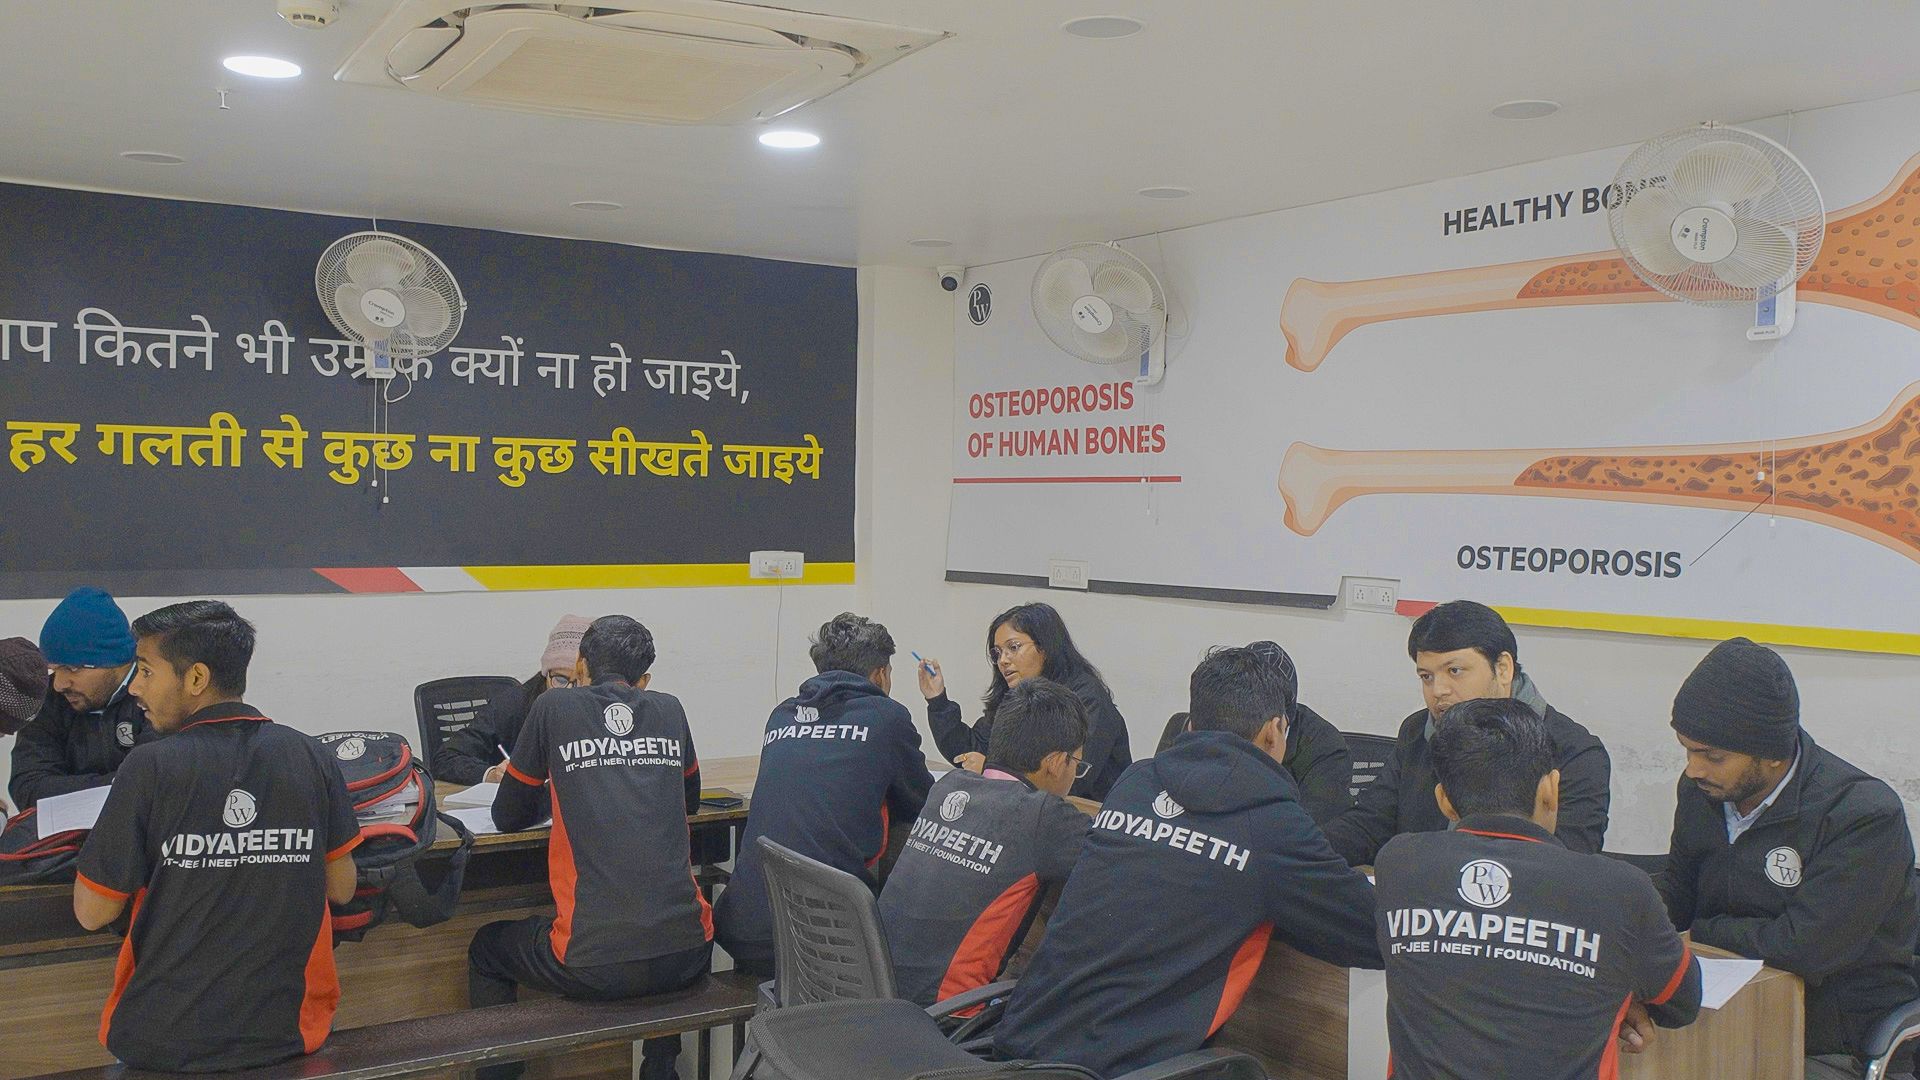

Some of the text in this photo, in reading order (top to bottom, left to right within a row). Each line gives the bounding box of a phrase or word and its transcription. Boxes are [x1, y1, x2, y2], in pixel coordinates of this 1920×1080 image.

[1443, 191, 1573, 236] HEALTHY
[73, 307, 219, 371] कितने
[236, 320, 295, 374] भी
[449, 336, 524, 386] क्यों
[536, 352, 579, 389] ना
[591, 343, 631, 398] हो
[643, 350, 750, 404] जाइये,
[969, 382, 1135, 418] OSTEOPOROSIS
[7, 412, 823, 487] हर गलती से कुछ ना कुछ सीखते जाइये
[968, 424, 1166, 458] OF HUMAN BONES
[1457, 545, 1682, 578] OSTEOPOROSIS
[558, 737, 681, 762] VIDYAPEETH
[764, 725, 869, 746] IDYAPEETH
[632, 758, 682, 767] FOUNDATION
[910, 816, 1003, 864] DYAPEETH
[1092, 810, 1251, 872] VIDYAPEETH
[208, 858, 239, 868] NEET
[240, 854, 311, 864] FOUNDATION
[932, 848, 992, 875] FOUNDATION
[1387, 908, 1601, 962] VIDYAPEETH
[1391, 941, 1430, 955] IIT-JEE
[1441, 942, 1483, 956] NEET
[1494, 948, 1596, 978] FOUNDATION
